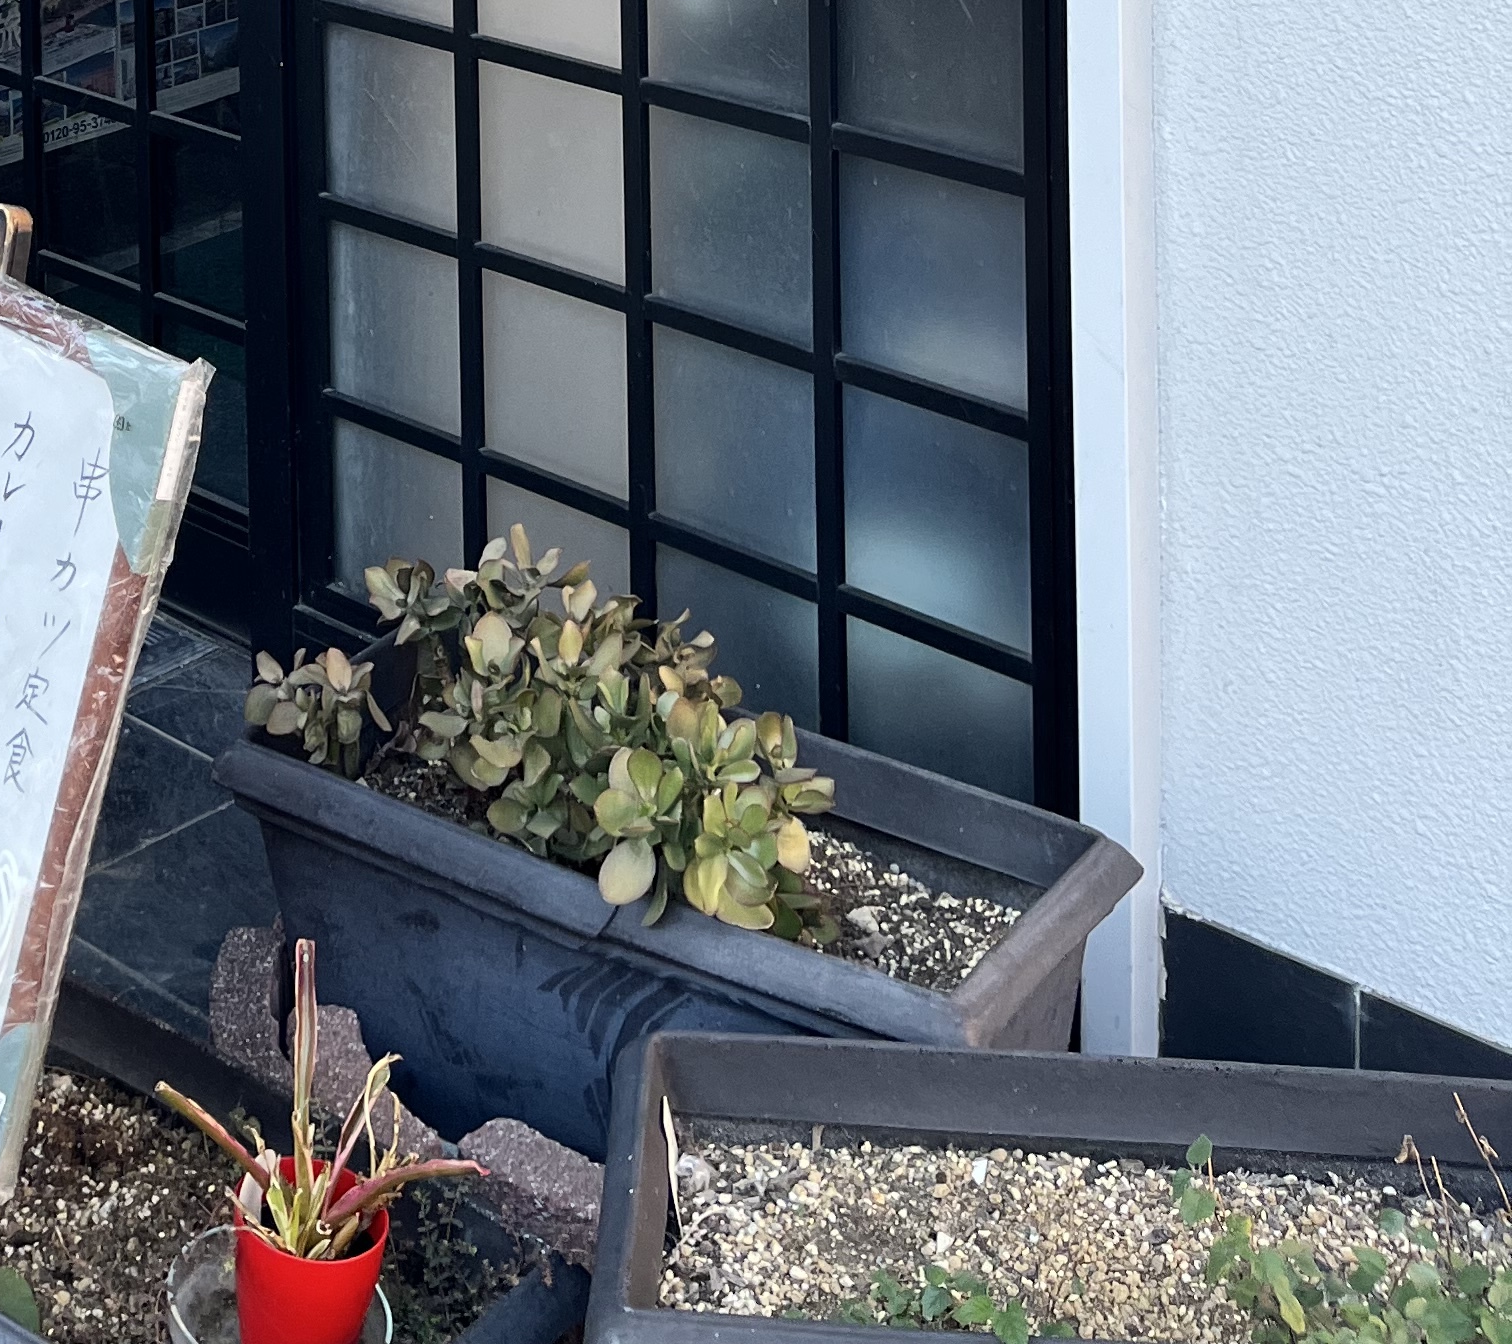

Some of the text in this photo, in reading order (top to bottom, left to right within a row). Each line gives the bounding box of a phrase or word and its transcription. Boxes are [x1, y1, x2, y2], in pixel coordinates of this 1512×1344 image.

[3, 448, 109, 794] 串カツ定食
